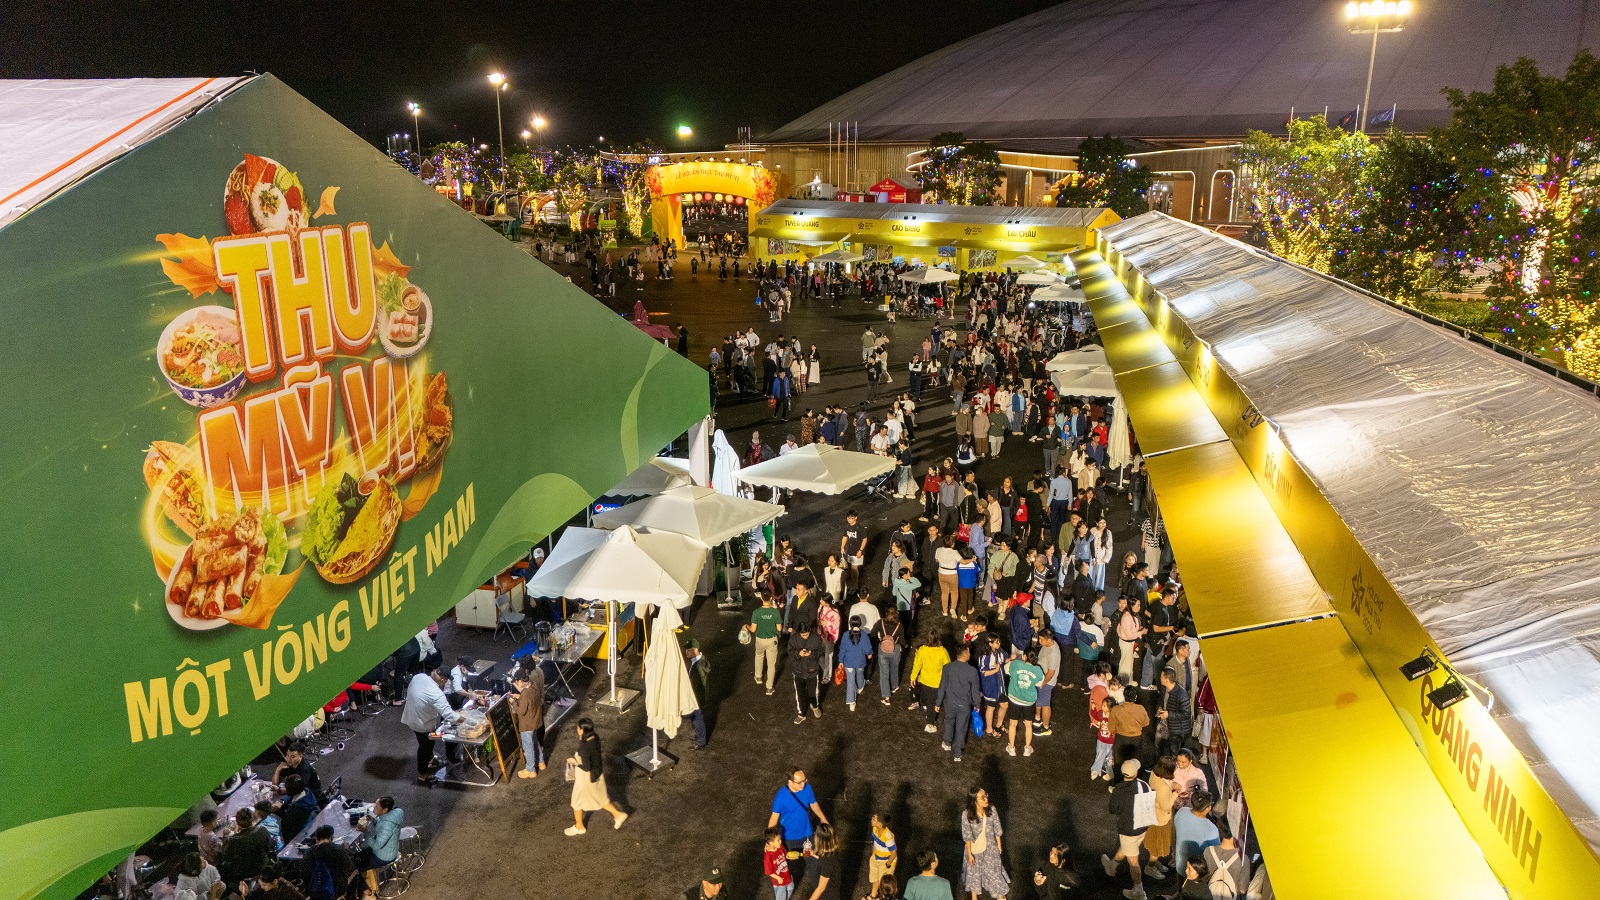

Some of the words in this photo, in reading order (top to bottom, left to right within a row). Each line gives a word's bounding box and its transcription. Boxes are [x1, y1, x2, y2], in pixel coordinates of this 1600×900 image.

[213, 224, 377, 374] THU
[200, 360, 332, 521] MỸ
[342, 356, 416, 474] VỊ
[123, 656, 232, 744] MỘT
[243, 599, 352, 701] VÒNG
[358, 549, 418, 632] VIỆT
[424, 481, 476, 577] NAM
[1483, 763, 1542, 884] NINH
